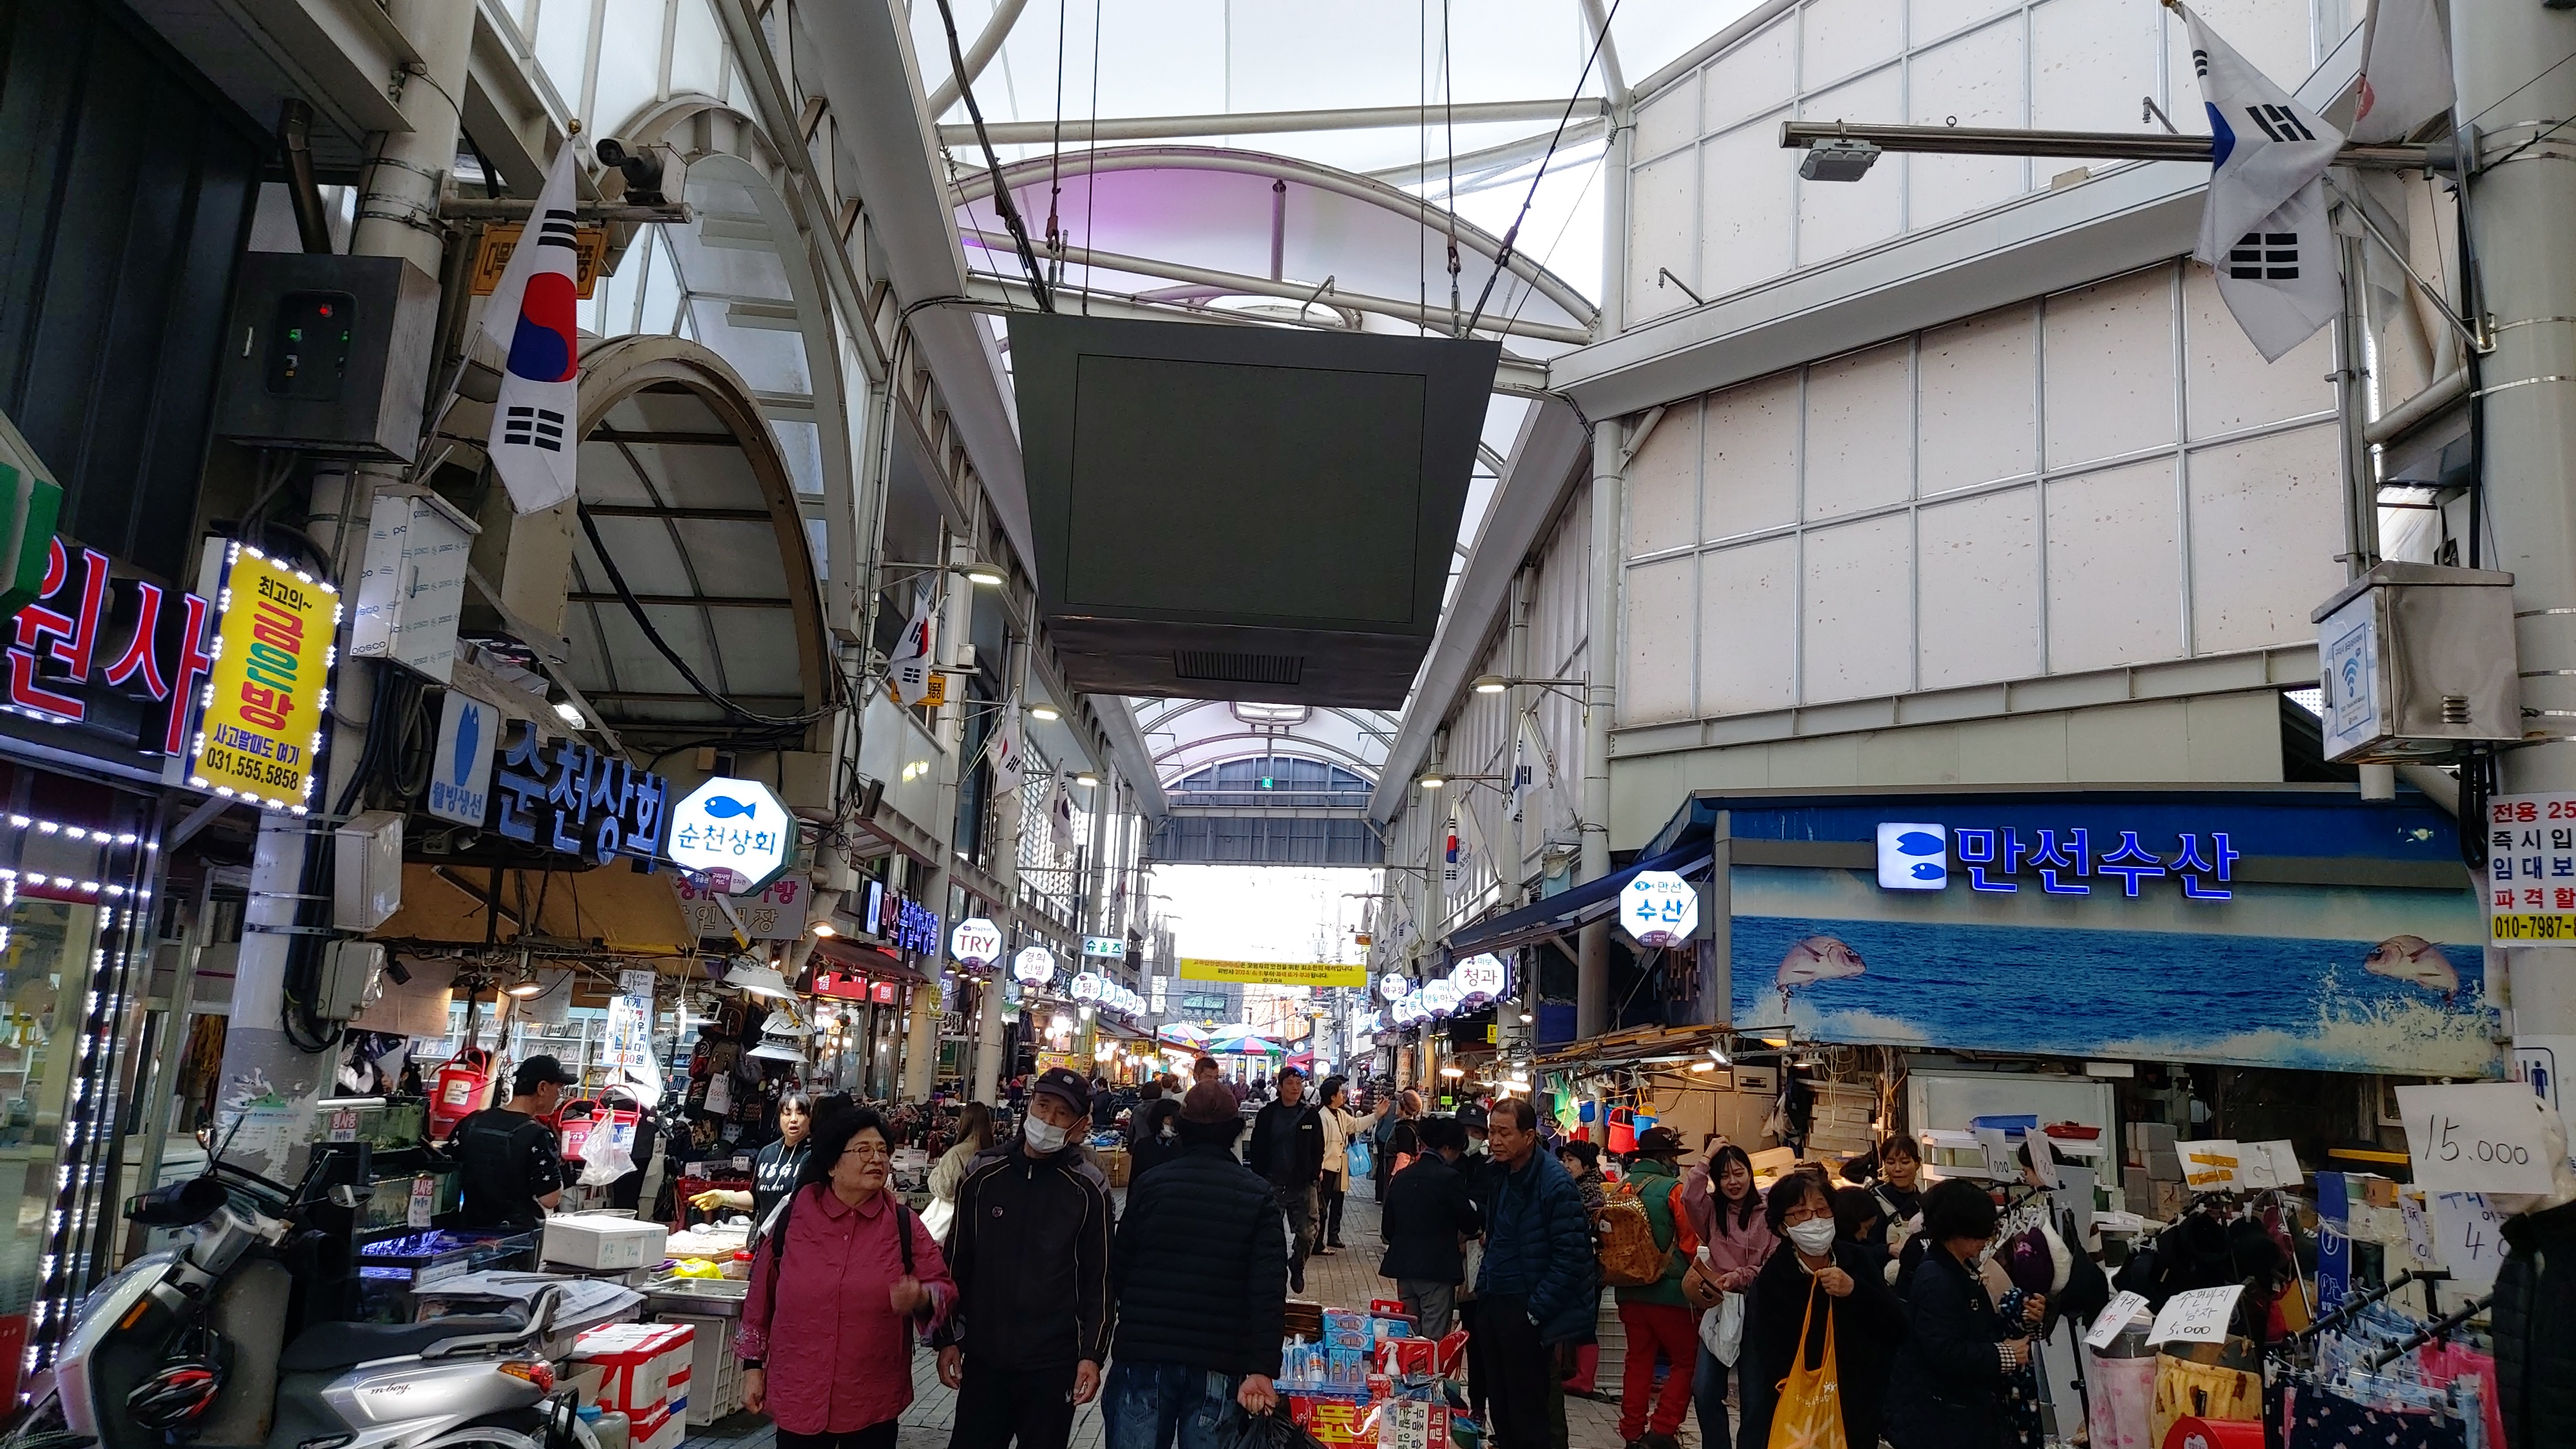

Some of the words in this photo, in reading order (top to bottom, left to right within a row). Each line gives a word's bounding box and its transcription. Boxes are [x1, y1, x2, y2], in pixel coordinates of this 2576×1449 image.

[238, 600, 305, 732] 금은방
[213, 723, 274, 759] 사고팔때도
[277, 742, 301, 766] 여기
[206, 747, 299, 791] 031.555.5858
[498, 719, 670, 875] 순천상회
[2493, 802, 2538, 823] 전용
[678, 823, 776, 855] 순천상회
[1955, 826, 2239, 900] 만선수산
[1658, 882, 1682, 893] 만선
[1636, 899, 1683, 922] 수산
[2495, 916, 2576, 938] 010-7987-
[959, 934, 995, 953] TRY
[1086, 940, 1122, 953] 슈올즈
[1025, 951, 1046, 963] 경희
[1023, 963, 1045, 976] 신발
[1464, 968, 1498, 986] 청과
[758, 1162, 801, 1179] MSG
[2177, 1288, 2230, 1308] 수면바지
[2185, 1308, 2218, 1321] 남자
